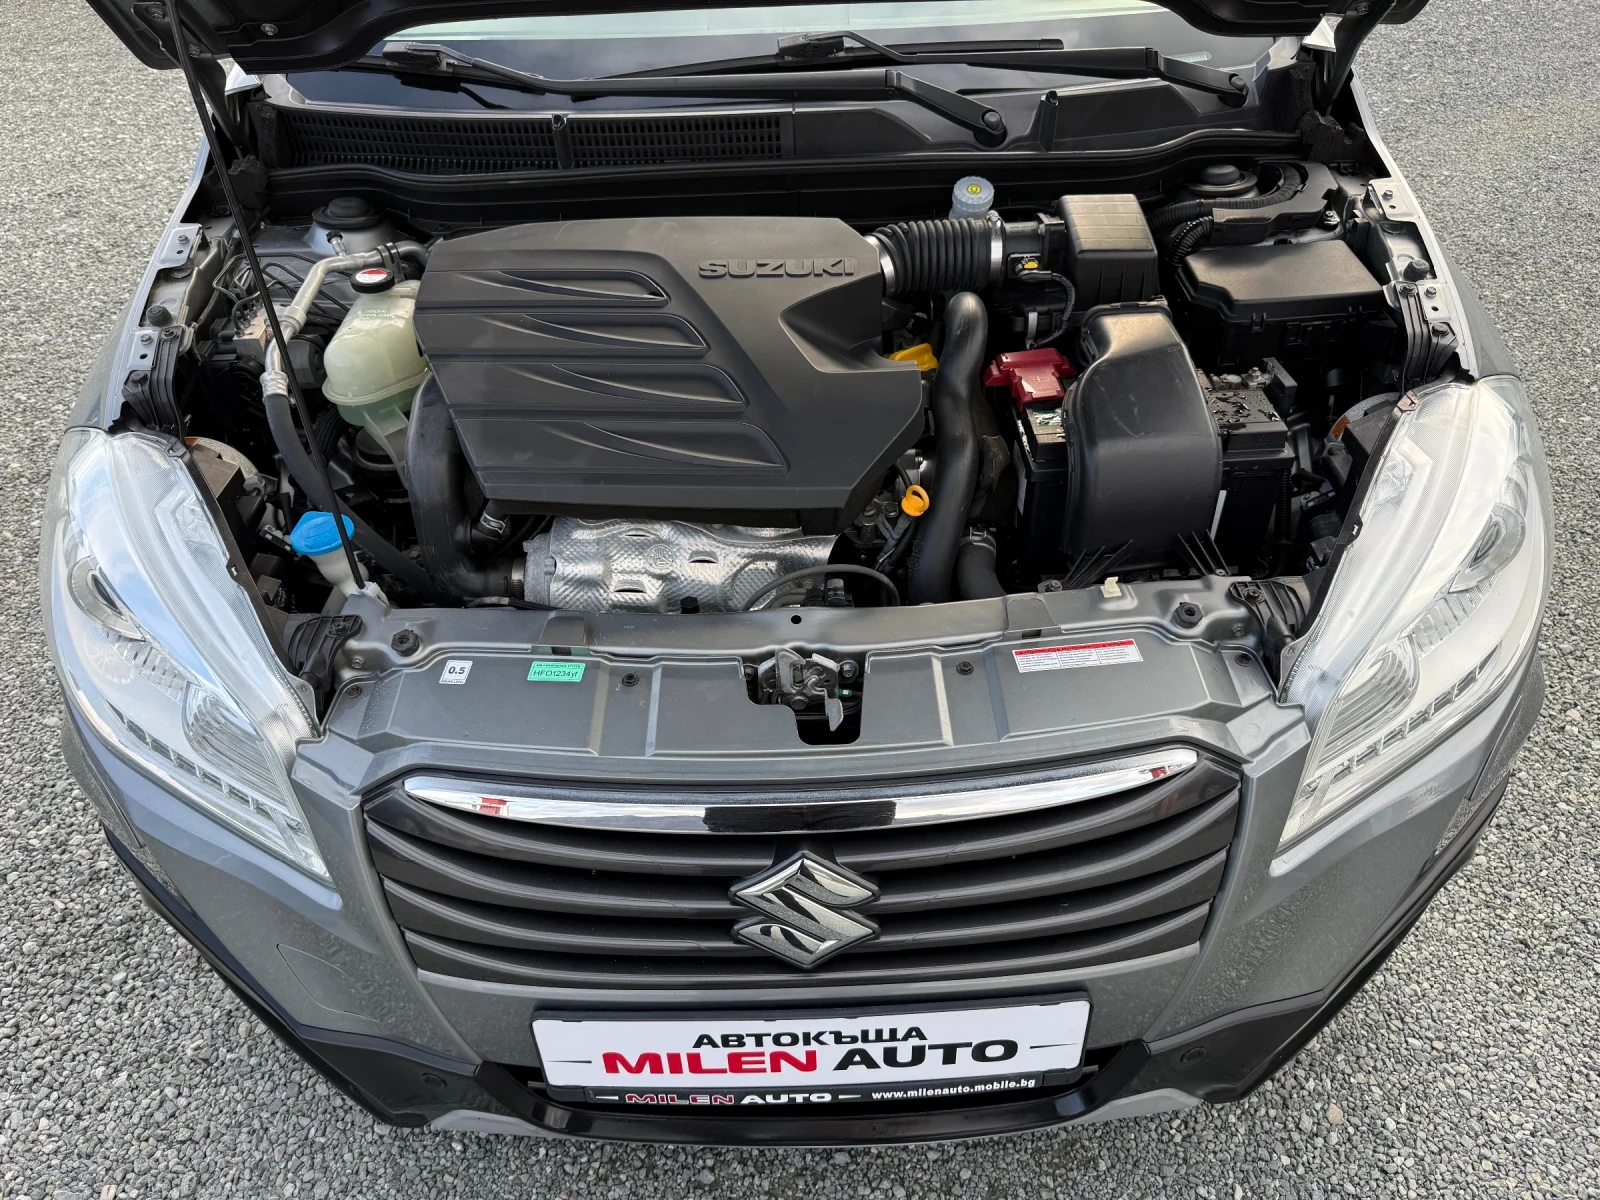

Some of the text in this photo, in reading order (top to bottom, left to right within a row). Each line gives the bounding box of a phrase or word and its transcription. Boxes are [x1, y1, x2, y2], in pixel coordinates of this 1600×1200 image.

[699, 258, 855, 278] SUZUKI
[448, 666, 465, 674] 0.5
[602, 1039, 1018, 1074] MILEN AUTO
[871, 1078, 1036, 1099] www.milenauto.mobile.bg
[625, 1092, 832, 1106] MILEN AUTO
